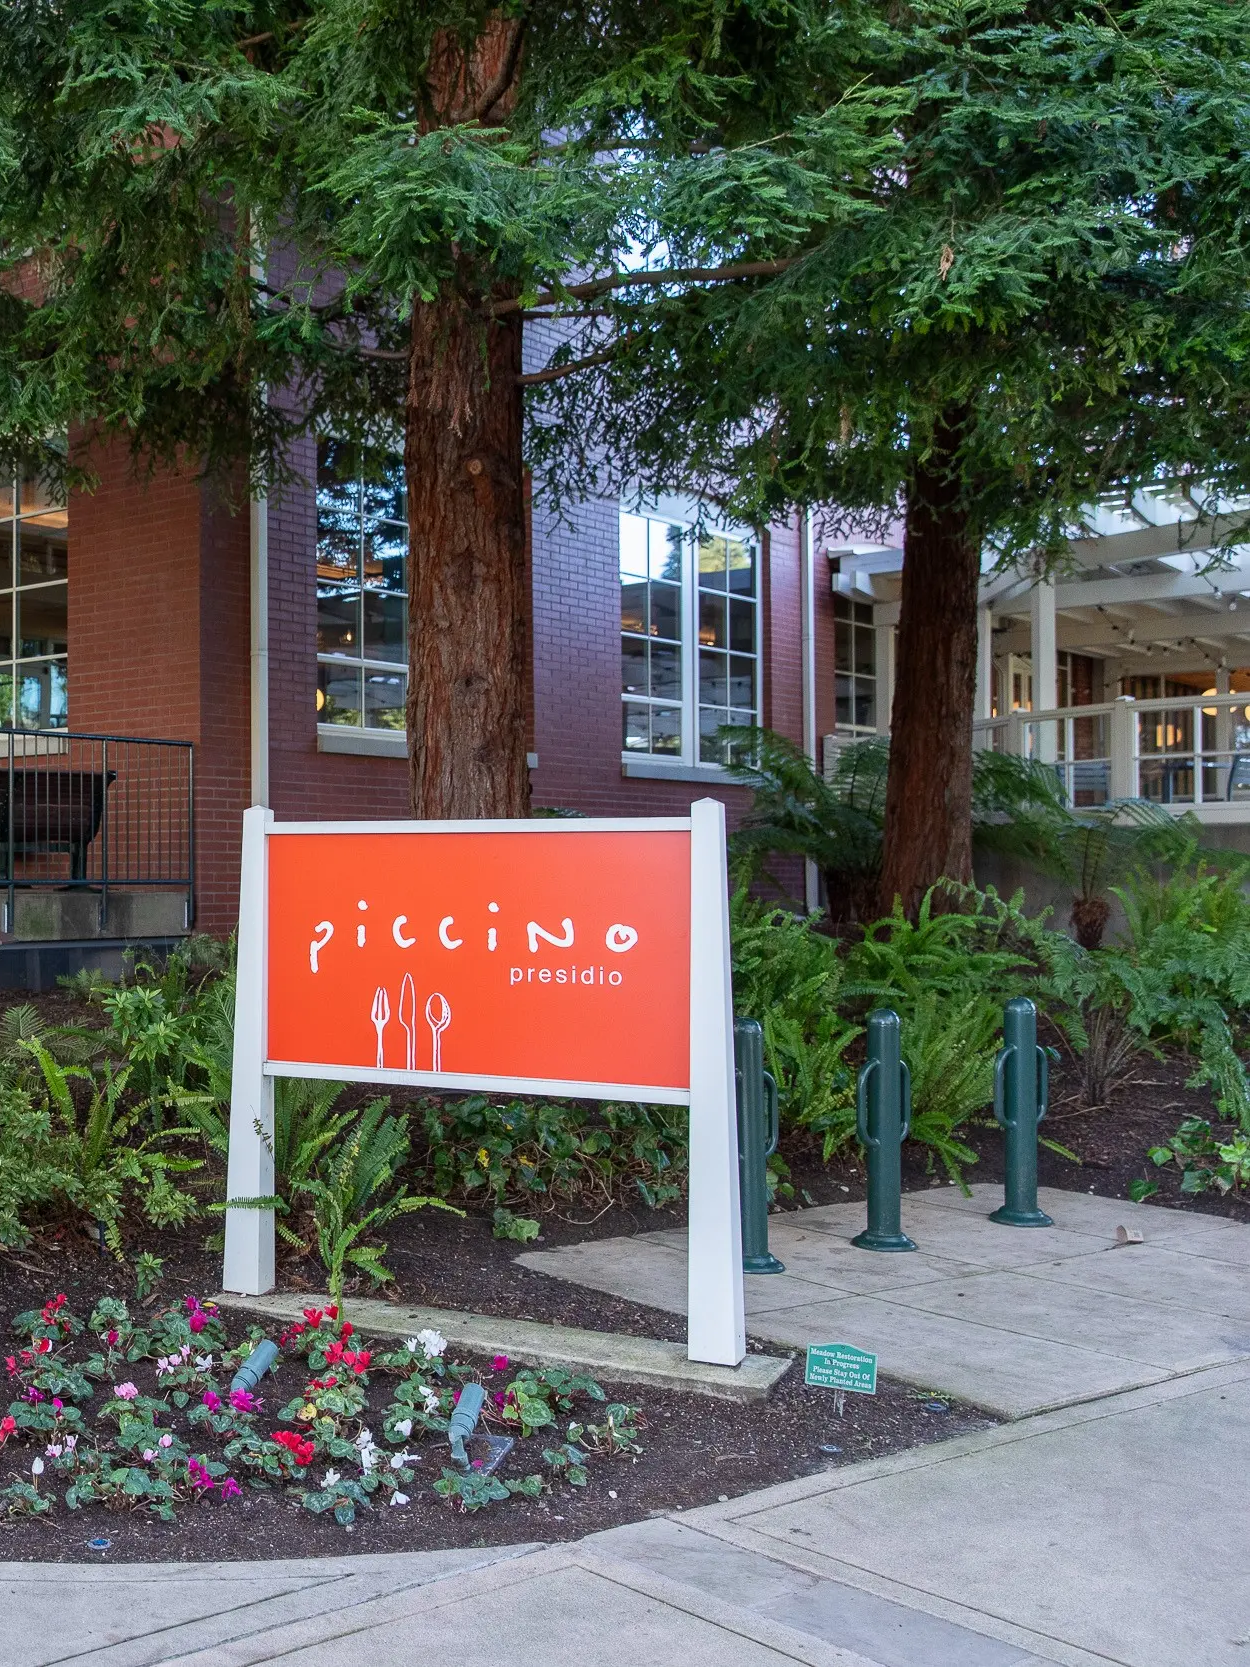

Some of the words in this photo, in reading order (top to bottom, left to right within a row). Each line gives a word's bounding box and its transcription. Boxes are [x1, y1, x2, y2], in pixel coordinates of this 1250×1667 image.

[510, 966, 623, 986] presidio
[810, 1348, 836, 1358] Meadow
[836, 1352, 873, 1364] Restoration
[832, 1360, 860, 1369] Progress
[809, 1373, 828, 1383] Newly
[830, 1376, 853, 1386] Planted
[854, 1380, 872, 1389] Areas
[813, 1366, 833, 1374] Please
[834, 1369, 848, 1378] Stay
[849, 1371, 860, 1379] Out
[862, 1373, 871, 1381] Of
